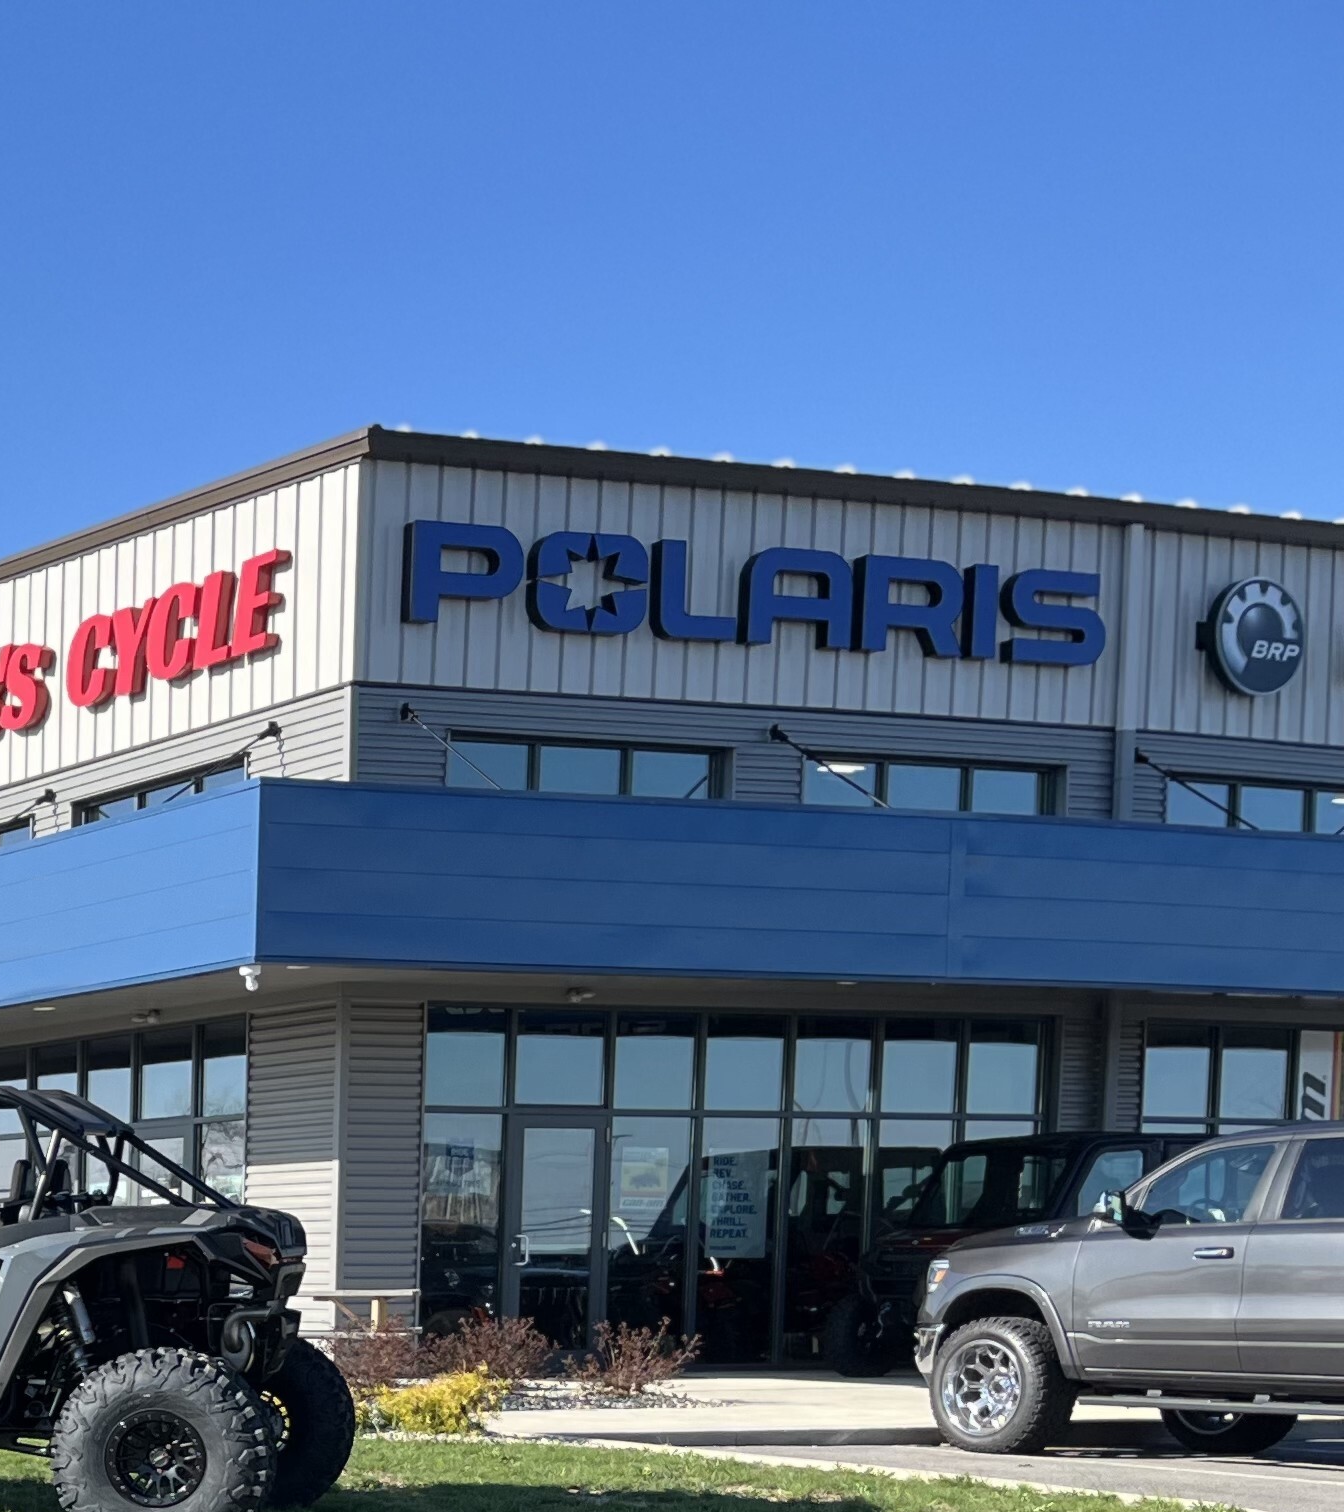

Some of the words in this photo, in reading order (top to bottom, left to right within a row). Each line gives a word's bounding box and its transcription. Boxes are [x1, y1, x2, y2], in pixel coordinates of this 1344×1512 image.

[66, 548, 291, 708] CYCLE
[402, 520, 1106, 667] POLARIS
[1251, 640, 1300, 661] BRP
